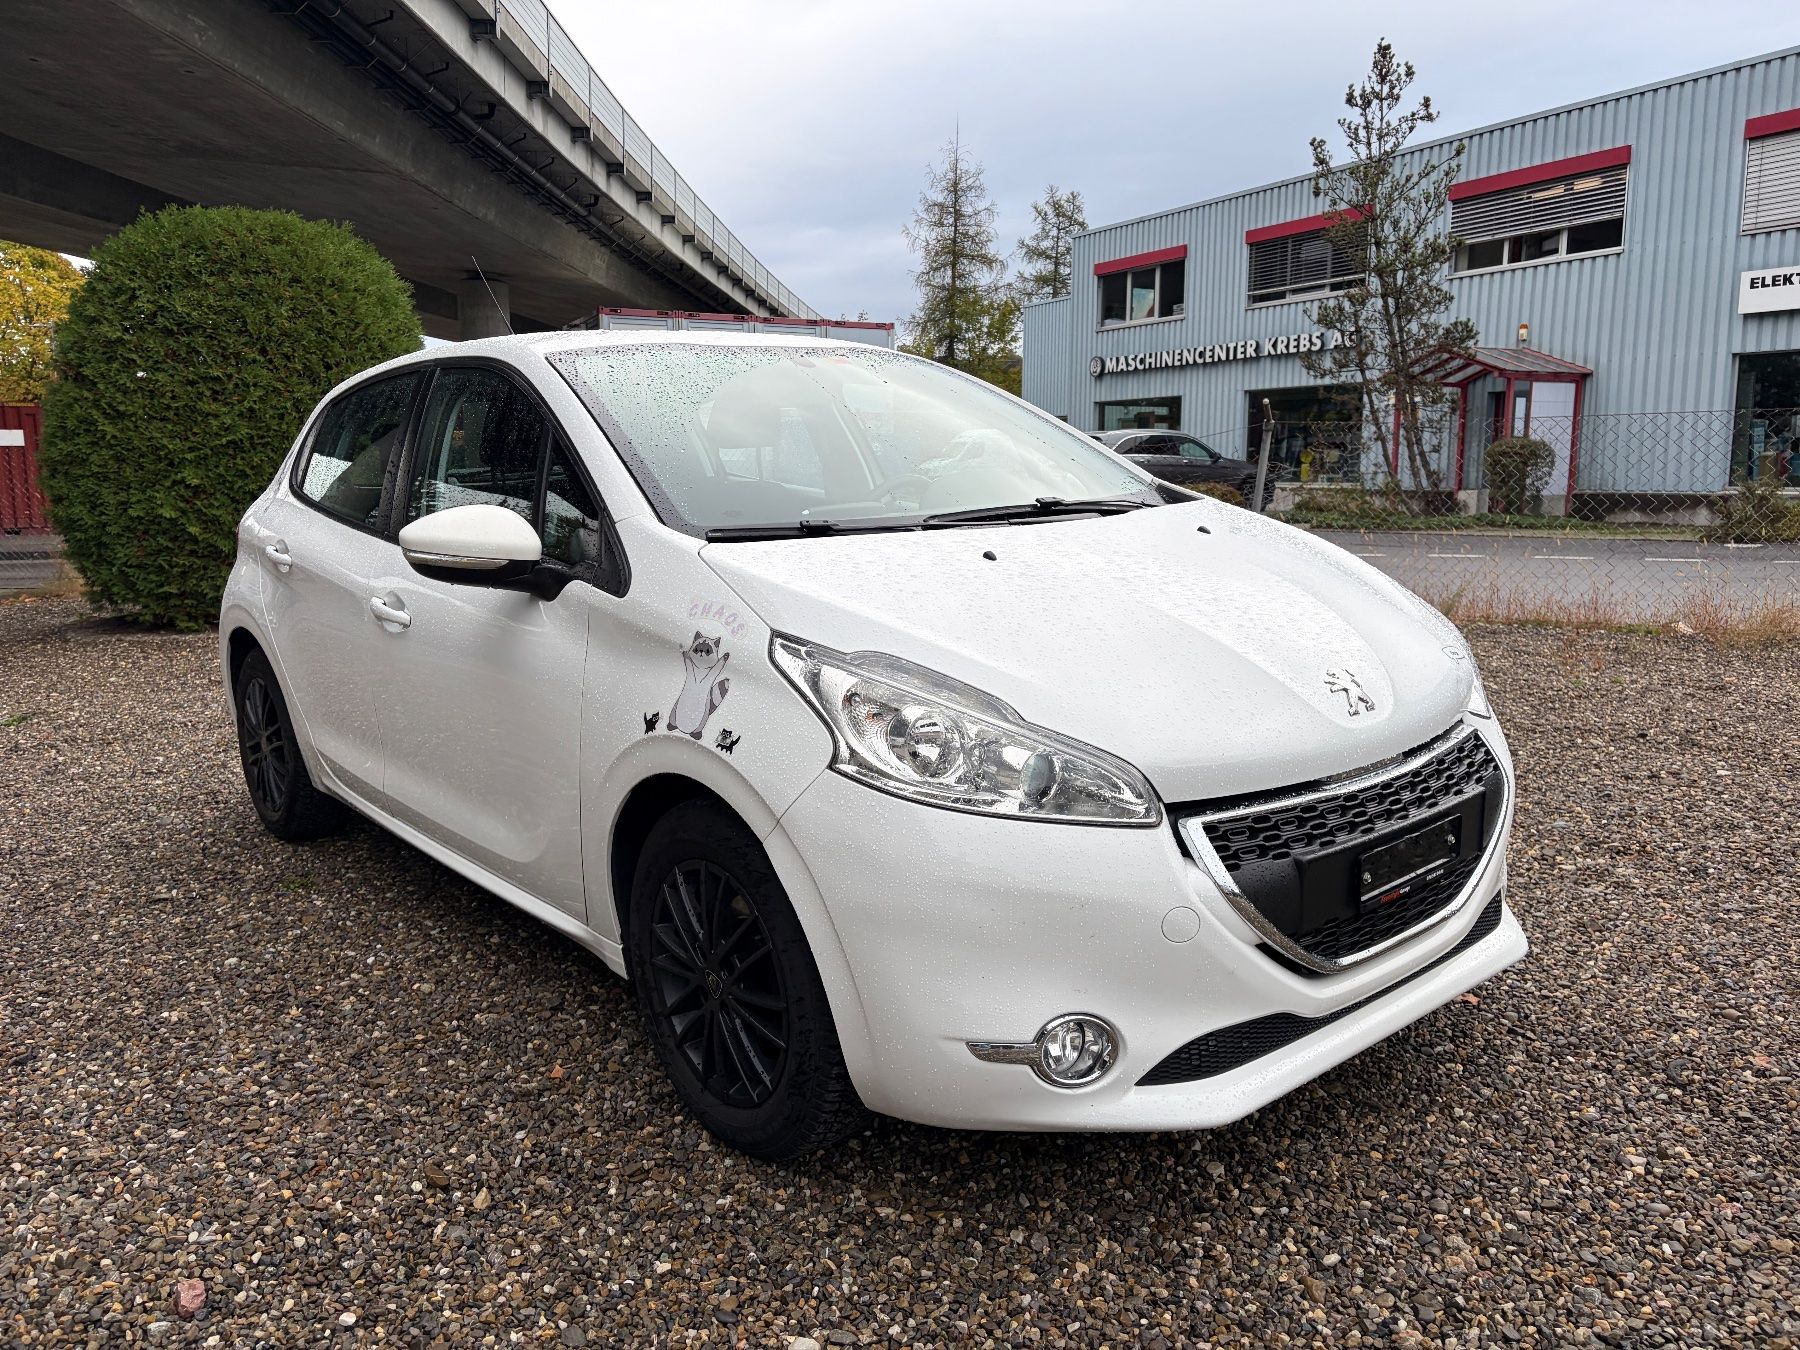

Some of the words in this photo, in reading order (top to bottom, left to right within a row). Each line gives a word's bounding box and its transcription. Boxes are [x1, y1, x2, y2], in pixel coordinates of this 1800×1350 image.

[1104, 340, 1258, 374] MASCHINENCENTER
[1265, 332, 1323, 356] KREBS
[689, 602, 745, 637] CHAOS
